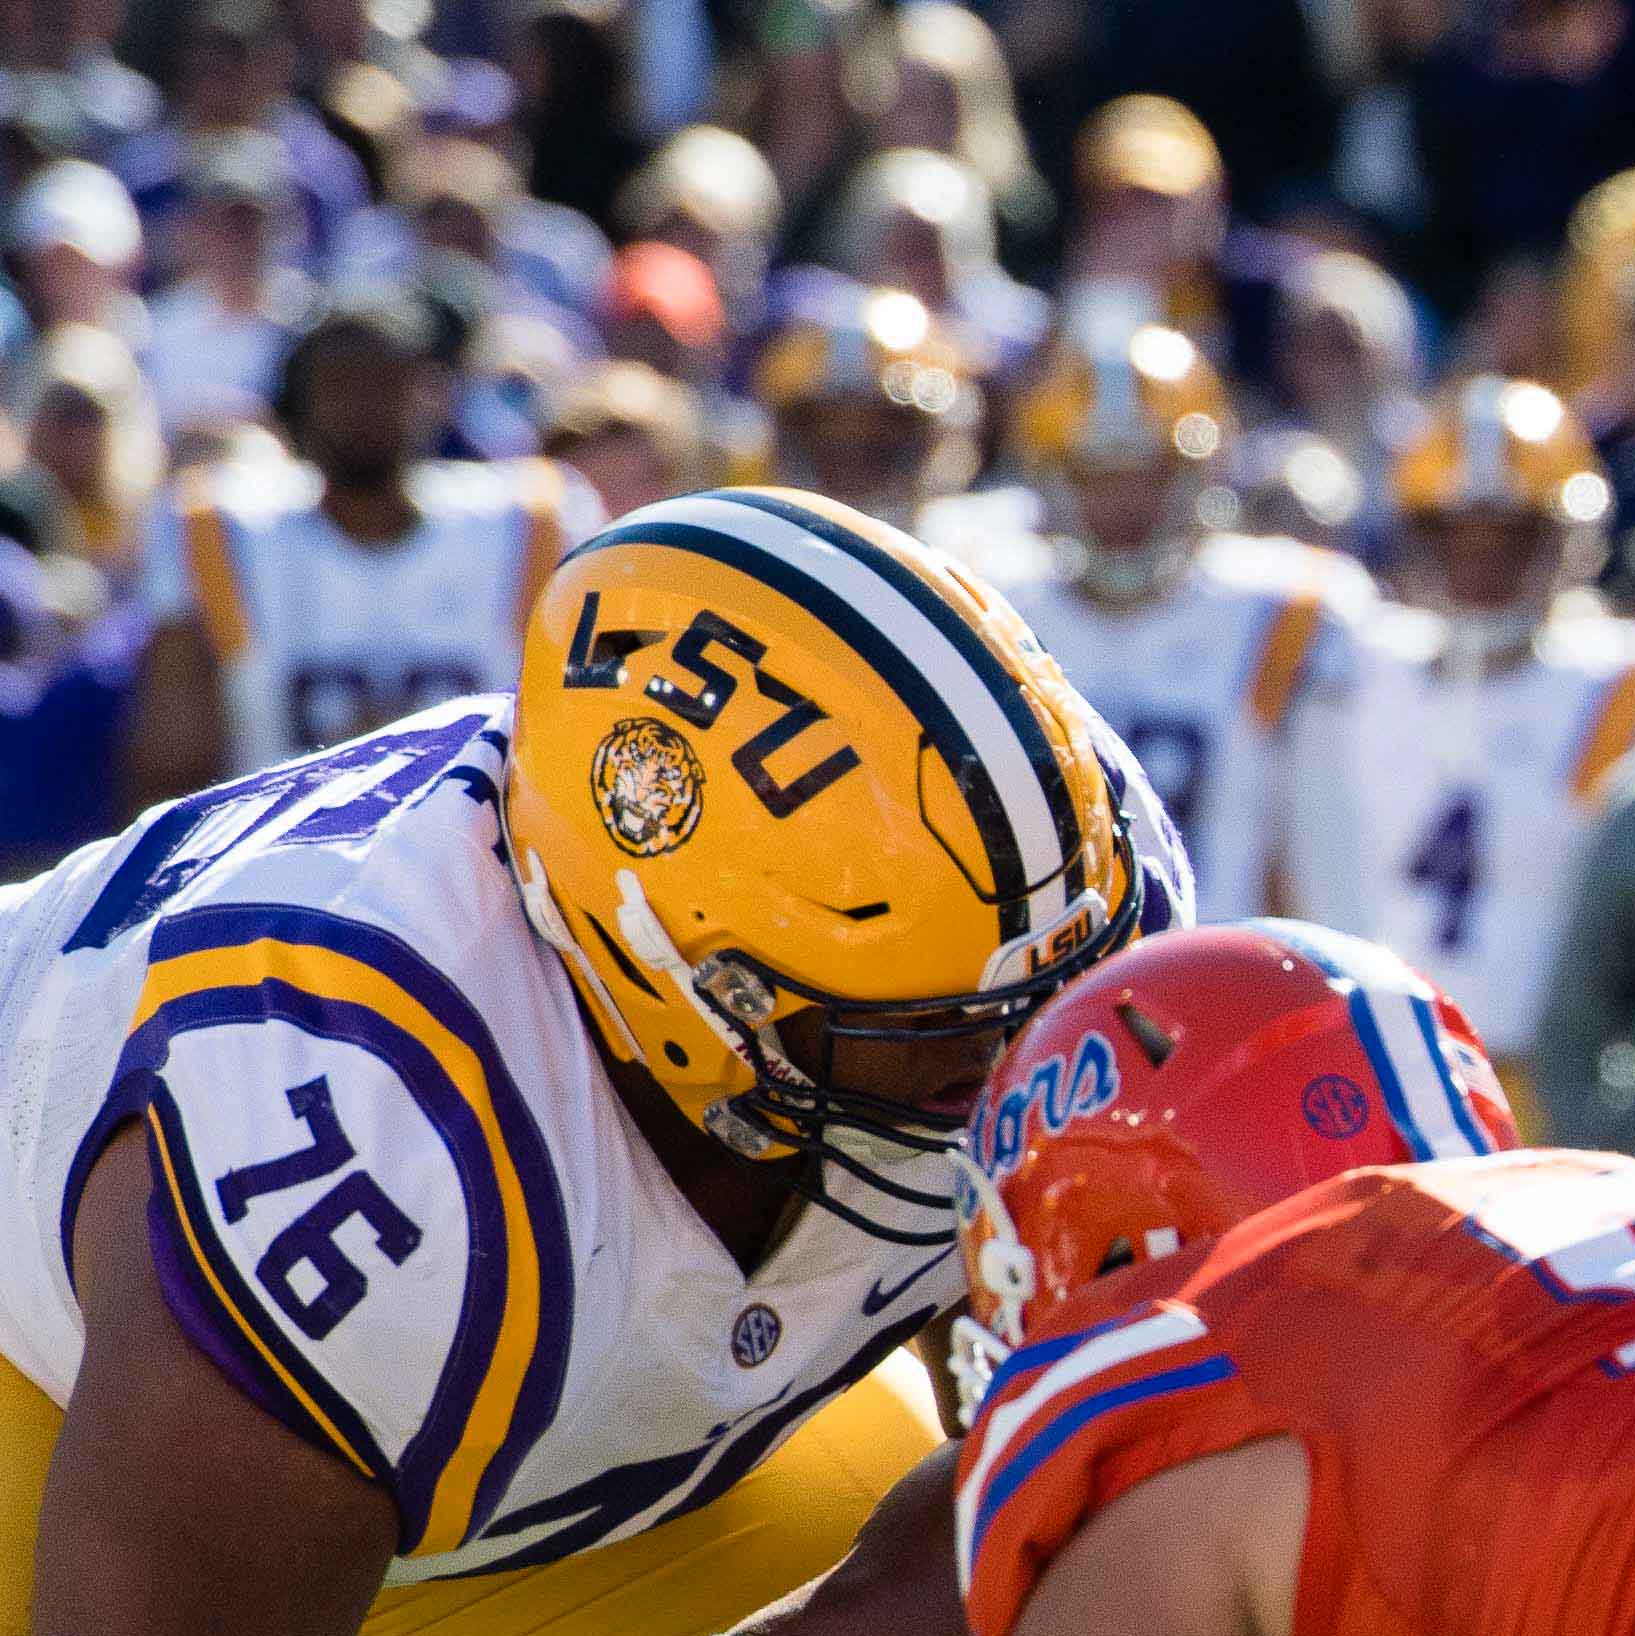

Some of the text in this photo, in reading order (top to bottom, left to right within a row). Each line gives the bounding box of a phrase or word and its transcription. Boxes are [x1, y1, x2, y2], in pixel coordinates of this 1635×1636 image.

[563, 591, 862, 820] LSU
[1024, 906, 1092, 978] LSU
[215, 1073, 424, 1343] 76
